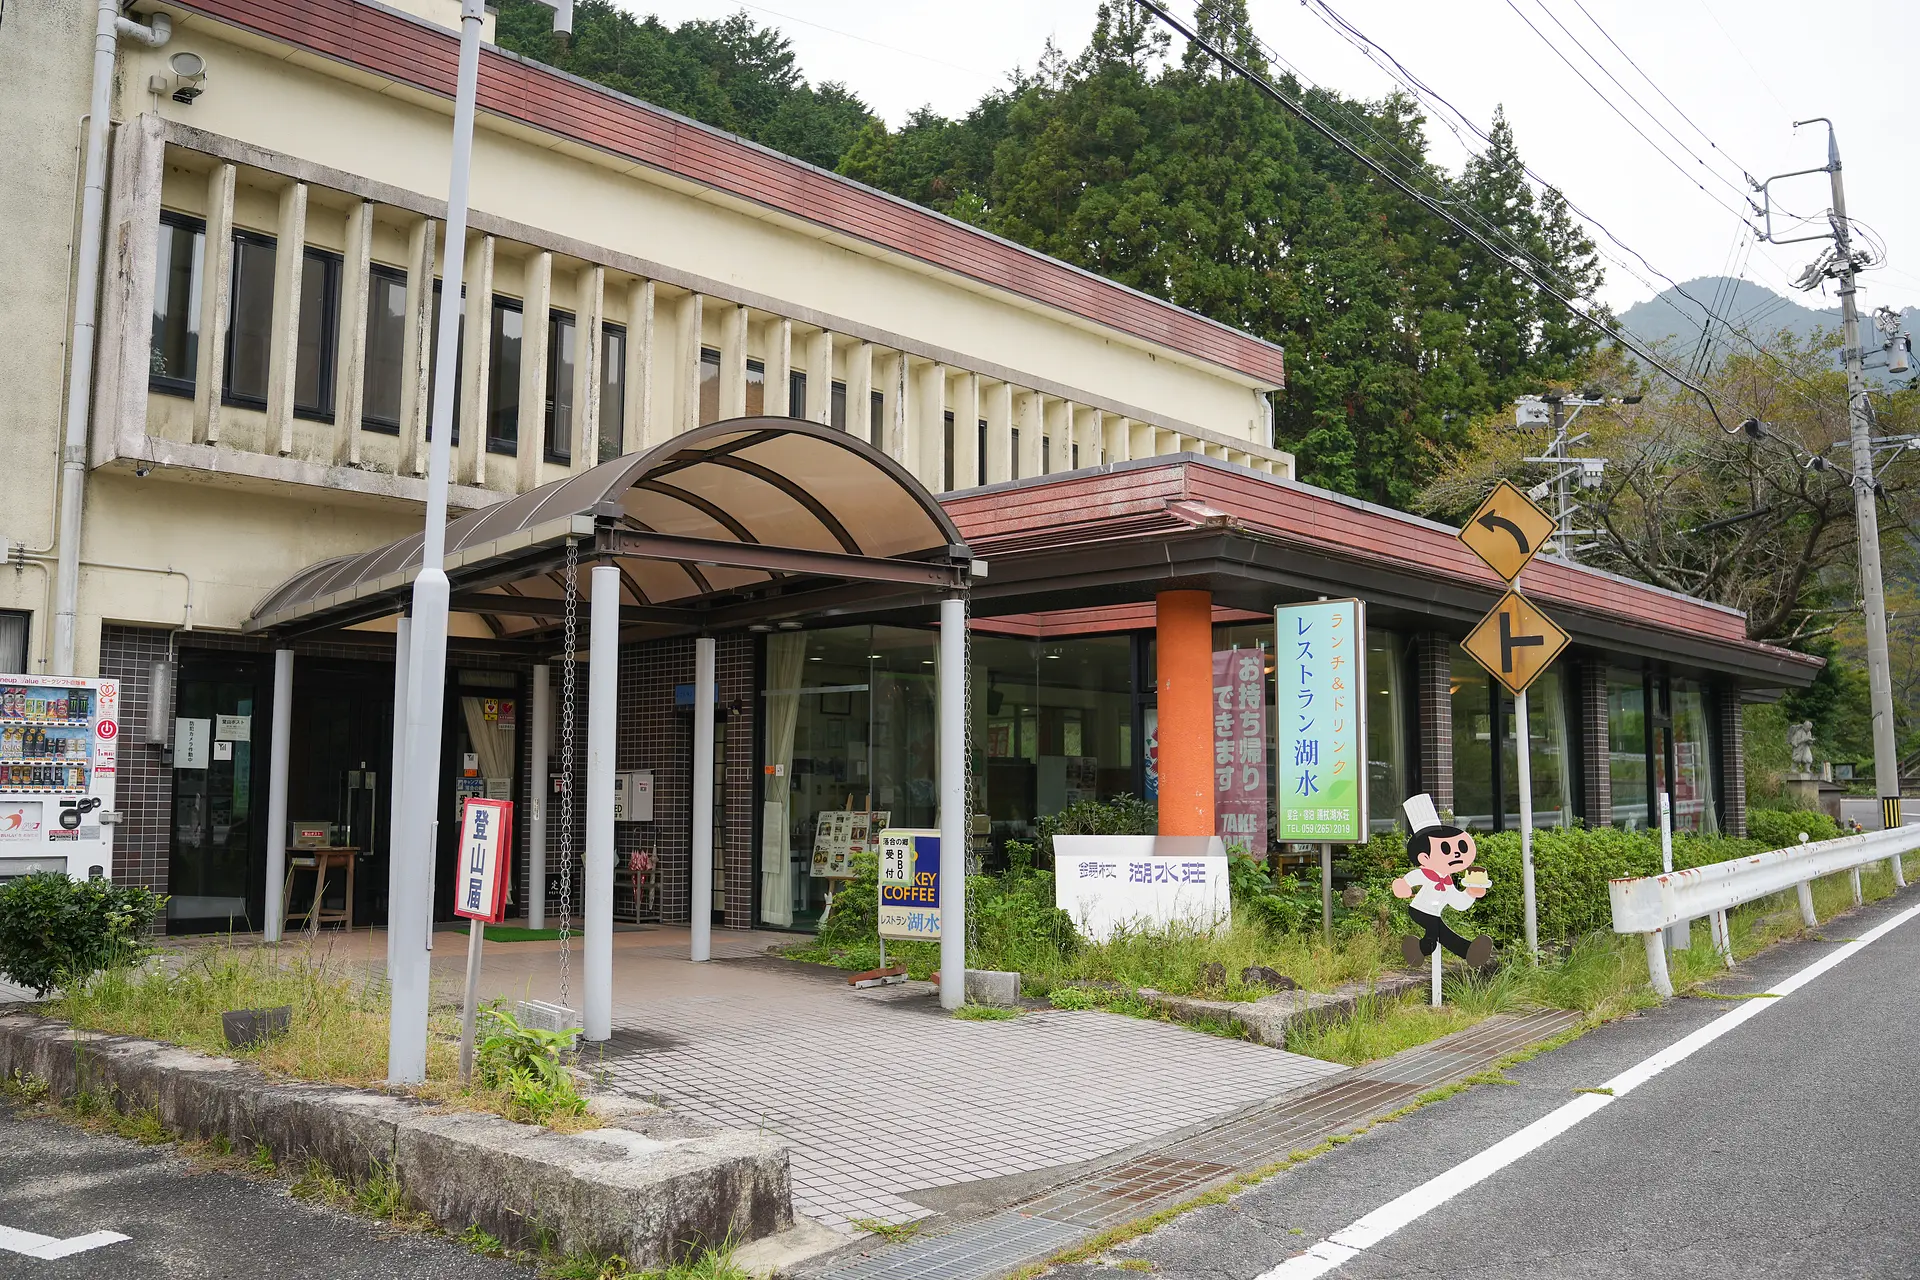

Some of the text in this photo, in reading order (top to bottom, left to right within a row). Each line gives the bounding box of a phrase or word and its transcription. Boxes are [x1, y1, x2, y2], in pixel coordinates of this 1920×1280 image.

[1331, 613, 1347, 776] ランチ&ドリンク
[1294, 616, 1320, 798] レストラン湖水
[1238, 656, 1262, 792] お持ち帰り
[1213, 684, 1235, 792] できます
[614, 804, 622, 812] ED
[1220, 813, 1257, 833] TAKE
[1286, 824, 1300, 833] TEL
[882, 838, 909, 846] 落合の郷
[466, 809, 490, 911] 登山届
[885, 849, 895, 879] 受付
[912, 872, 937, 887] KEY
[1078, 861, 1206, 884] 錫杖 湖水荘
[883, 885, 936, 902] COFFEE
[880, 911, 940, 933] レストラン湖水
